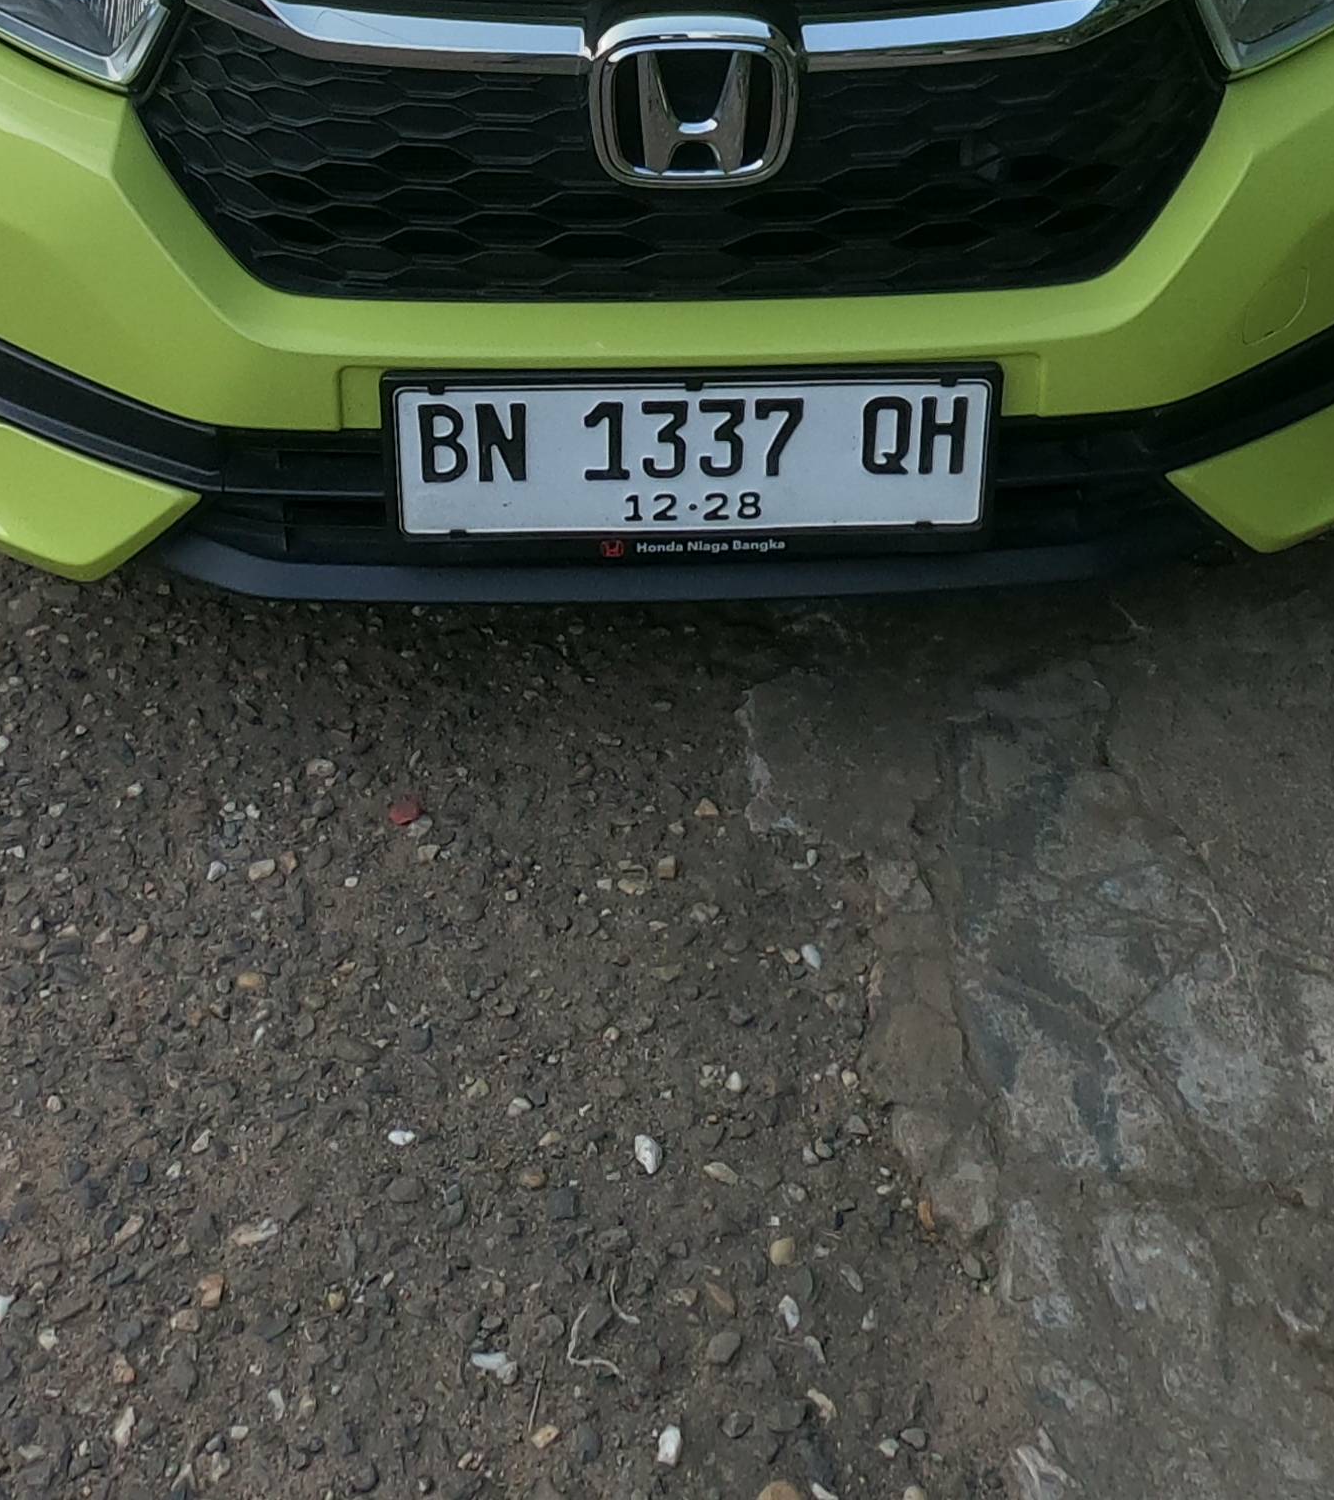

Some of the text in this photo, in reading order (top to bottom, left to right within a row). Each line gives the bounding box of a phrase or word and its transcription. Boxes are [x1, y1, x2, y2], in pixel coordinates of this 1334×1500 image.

[417, 394, 970, 484] BN 1337 QH
[636, 542, 684, 553] Honda
[687, 540, 729, 553] Niaga
[732, 538, 786, 552] Bangka
